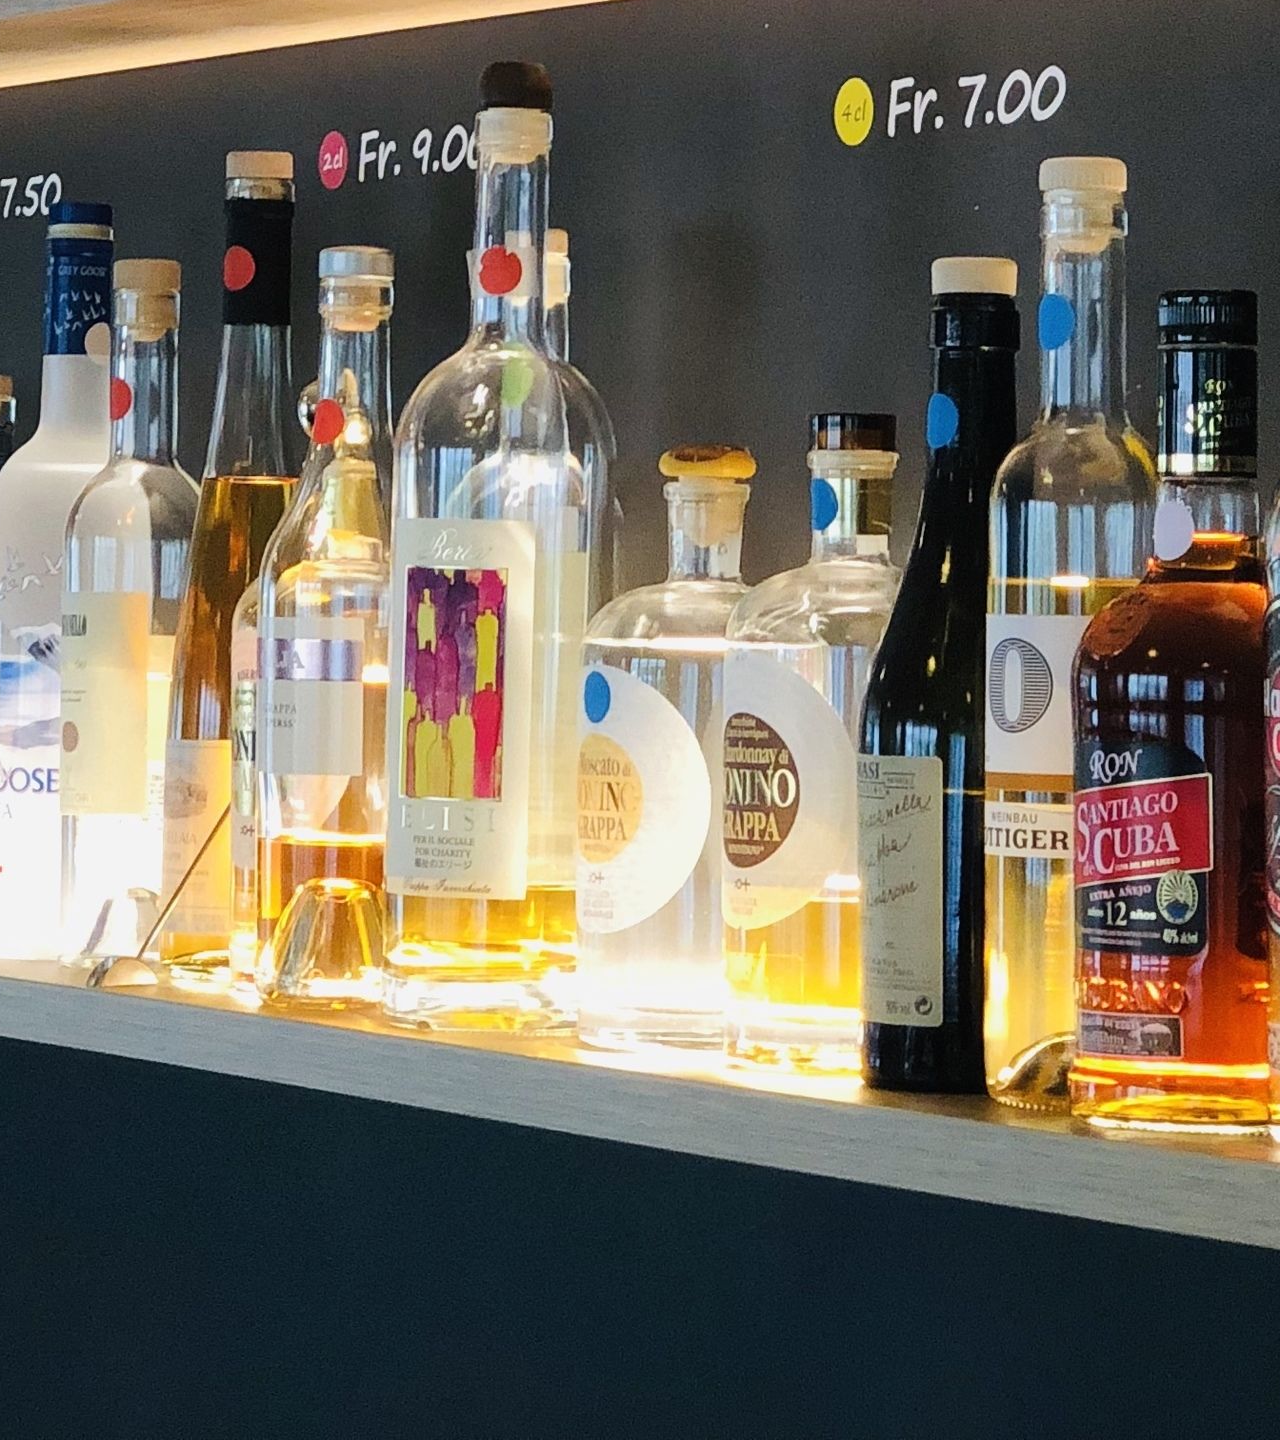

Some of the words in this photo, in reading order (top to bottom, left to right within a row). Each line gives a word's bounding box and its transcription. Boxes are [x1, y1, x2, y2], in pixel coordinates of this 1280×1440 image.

[887, 76, 944, 138] Fr.
[958, 64, 1067, 128] 7.00
[358, 130, 401, 183] Fr.
[0, 173, 63, 219] 7.50
[1090, 748, 1143, 784] RON
[991, 812, 1038, 824] WEINBAU
[1077, 791, 1179, 863] SANTIAGO
[431, 848, 472, 859] CHARITY
[985, 826, 1069, 851] TTIGER
[1083, 863, 1095, 876] de
[1094, 821, 1180, 875] CUBA
[1089, 887, 1116, 902] EXTRA
[1119, 883, 1152, 900] AÑEJO
[1106, 901, 1127, 926] 12
[1129, 907, 1157, 922] años
